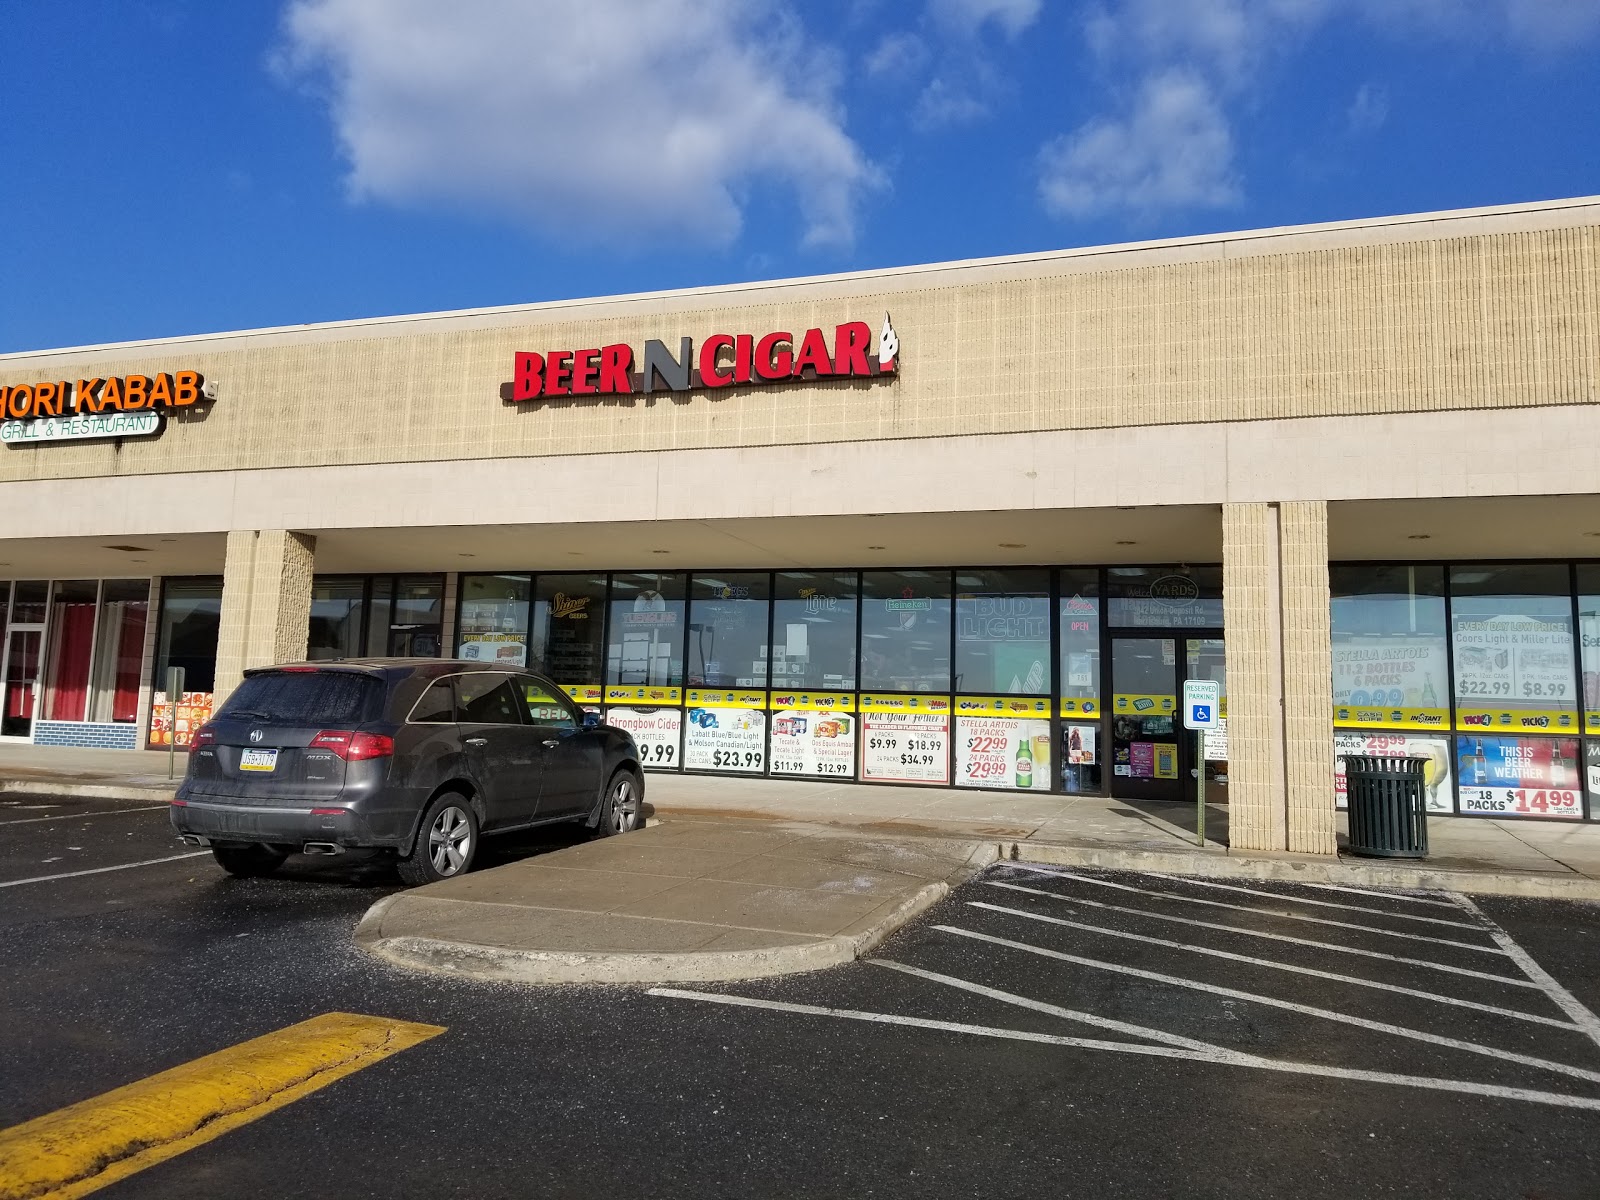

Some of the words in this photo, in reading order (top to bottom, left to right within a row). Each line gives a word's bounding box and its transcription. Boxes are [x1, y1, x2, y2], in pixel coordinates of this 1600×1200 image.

[513, 343, 631, 401] BEER
[644, 337, 692, 393] N
[700, 321, 871, 387] CIGAR
[75, 370, 198, 413] KABAB
[1, 421, 39, 439] GRILL
[46, 422, 54, 437] &
[61, 415, 157, 436] RESTAURANT
[1154, 585, 1195, 596] YARDS
[805, 594, 837, 615] Lite
[888, 600, 928, 609] Heineken
[975, 597, 1033, 616] BUD
[1071, 621, 1089, 631] OPEN
[1173, 616, 1183, 625] PA
[1184, 617, 1206, 626] 17109
[1458, 621, 1489, 632] EVERY
[1490, 621, 1509, 632] DAY
[1511, 622, 1532, 632] LOW
[962, 617, 1044, 638] LIGHT
[463, 634, 481, 643] EVERY
[1456, 633, 1483, 643] Coors
[1485, 634, 1509, 645] Light
[1511, 635, 1518, 643] &
[1521, 634, 1549, 643] Miller
[1551, 635, 1571, 644] Lite
[1335, 649, 1380, 663] STELLA
[1381, 647, 1429, 661] ARTOIS
[1366, 661, 1416, 674] BOTTLES
[1365, 674, 1402, 686] PACKS
[1186, 684, 1217, 693] RESERVED
[1459, 679, 1511, 695] $22.99
[1523, 681, 1566, 697] $8.99
[609, 716, 656, 731] Strongbow
[657, 717, 681, 730] Cider
[961, 719, 988, 728] STELLA
[989, 720, 1019, 729] ARTOIS
[743, 732, 759, 741] Light
[970, 728, 978, 736] 18
[979, 728, 1006, 737] PACKS
[716, 740, 762, 750] Canadian/Light
[870, 737, 897, 749] $9.99
[908, 739, 942, 751] $18.99
[1336, 740, 1361, 748] PACKS
[636, 743, 675, 762] 9.99
[1499, 746, 1521, 757] THIS
[1523, 746, 1534, 757] IS
[712, 749, 762, 768] $23.99
[901, 752, 934, 766] $34.99
[979, 754, 1006, 763] PACKS
[1504, 757, 1531, 768] BEER
[773, 760, 804, 771] $11.99
[817, 762, 847, 773] $12.99
[1494, 767, 1544, 779] WEATHER
[1479, 790, 1493, 799] 18
[1467, 799, 1506, 811] PACKS
